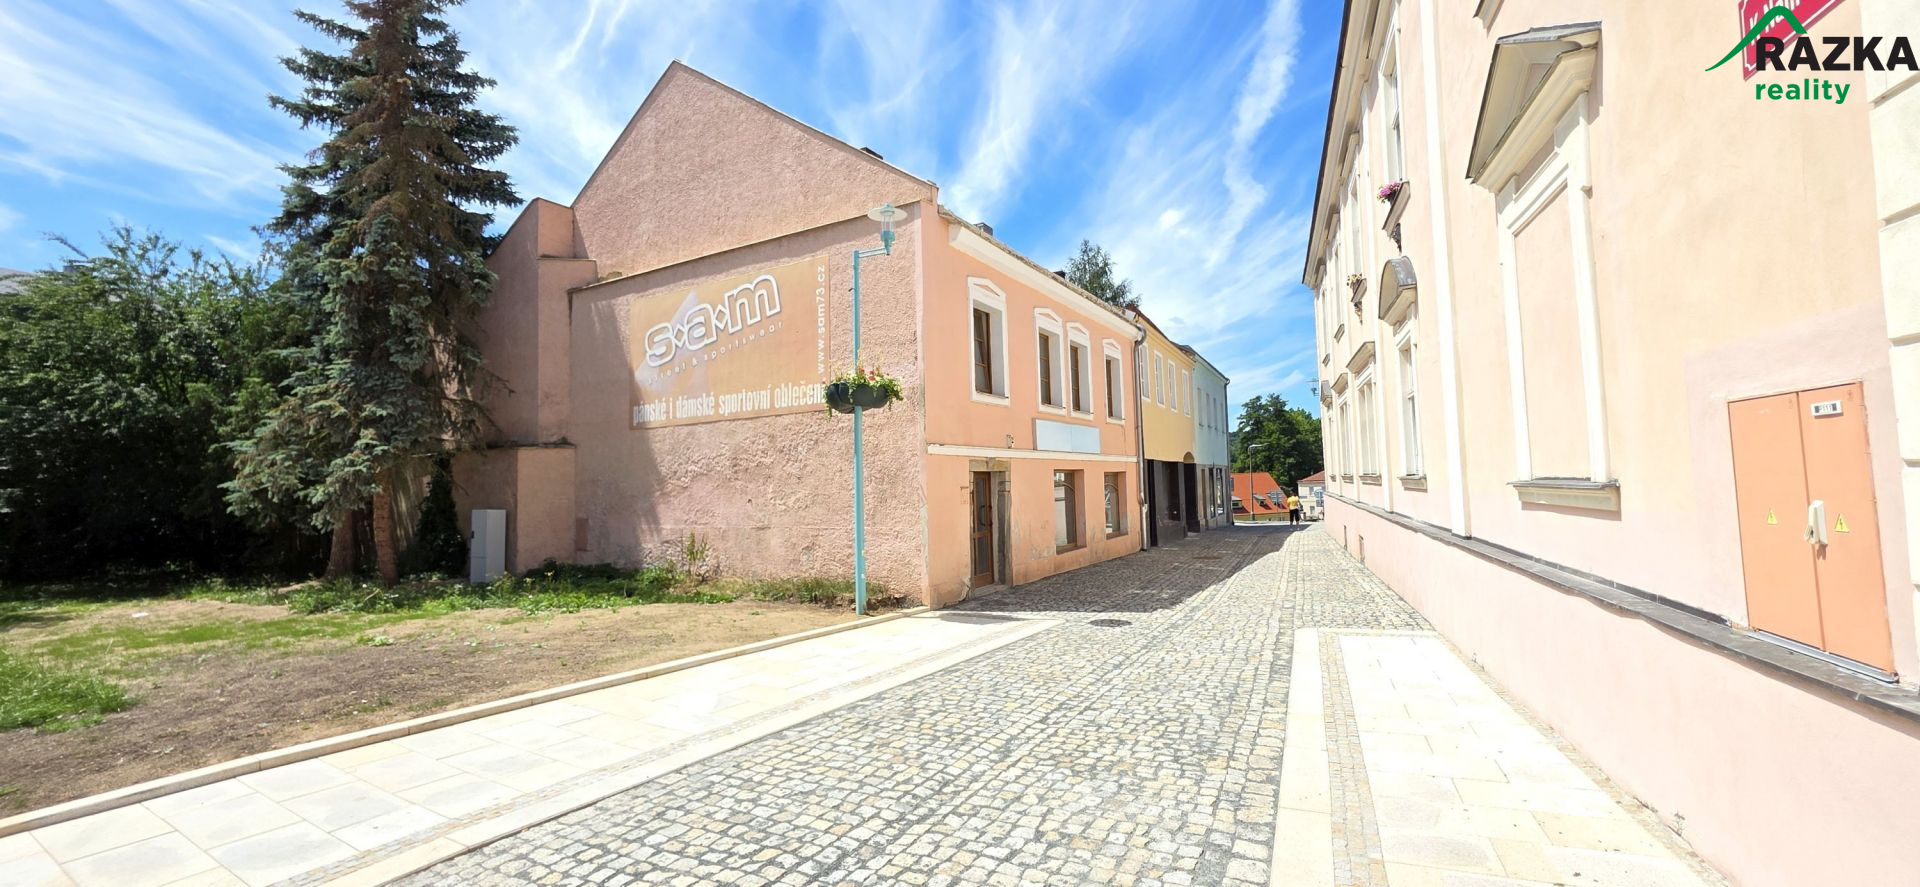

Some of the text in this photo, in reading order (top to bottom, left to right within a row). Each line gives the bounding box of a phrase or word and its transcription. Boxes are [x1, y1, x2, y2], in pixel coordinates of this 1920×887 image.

[816, 264, 826, 374] www.sam73.cz
[704, 320, 784, 362] sportswear
[633, 397, 667, 426] pánské
[676, 392, 715, 419] dámské
[719, 383, 772, 416] sportovní
